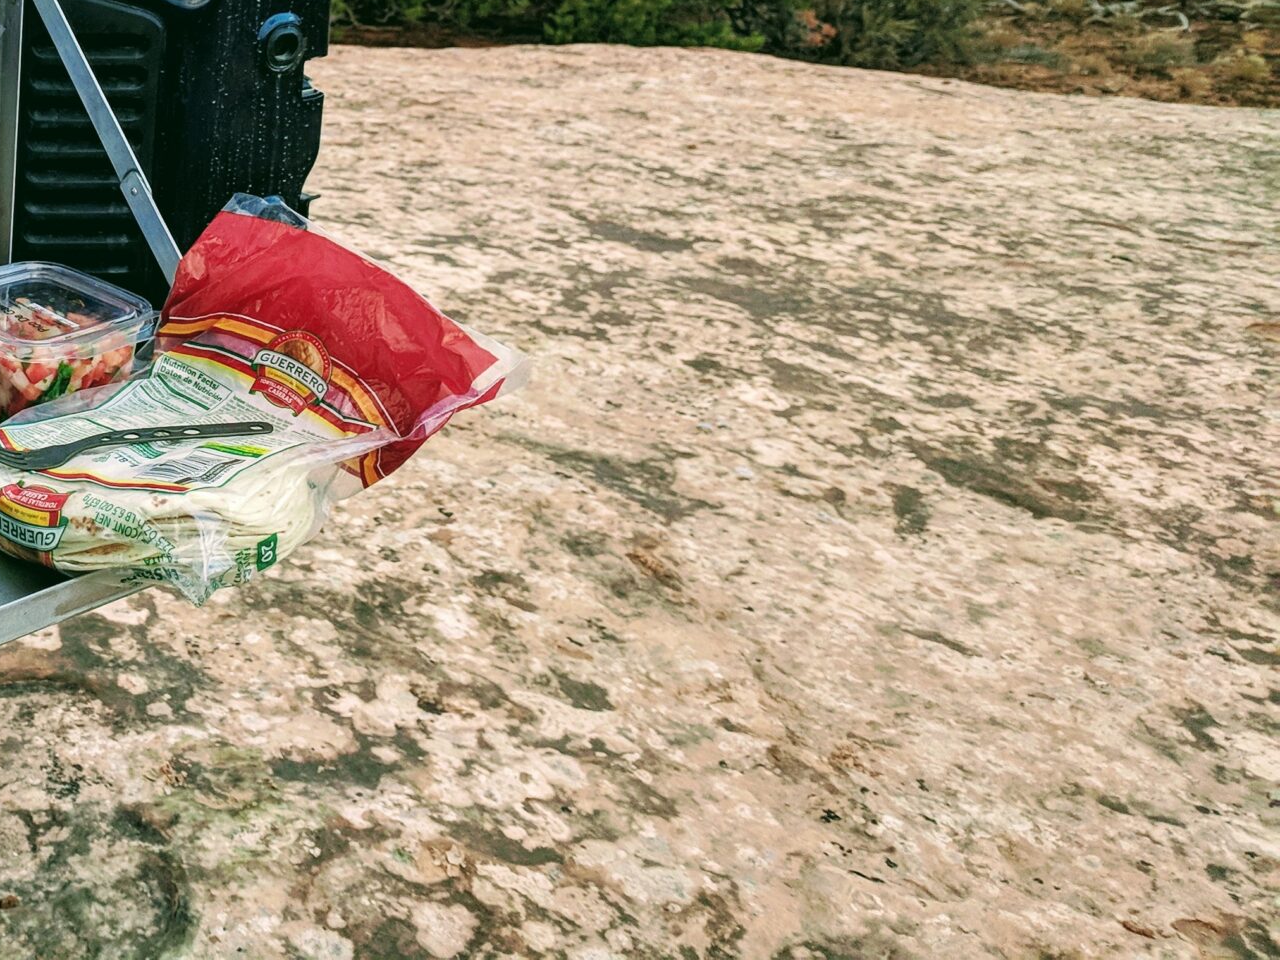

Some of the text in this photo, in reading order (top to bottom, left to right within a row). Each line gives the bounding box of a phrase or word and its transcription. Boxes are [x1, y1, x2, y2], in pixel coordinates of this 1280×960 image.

[162, 356, 197, 377] Nutrition
[260, 352, 325, 394] GUERRERO
[159, 364, 182, 379] Datos
[182, 375, 193, 385] de
[192, 380, 222, 401] Nutrición
[267, 386, 292, 403] CASERAS
[27, 498, 57, 507] TORTILLAS
[125, 511, 136, 523] LB
[261, 541, 274, 563] 20
